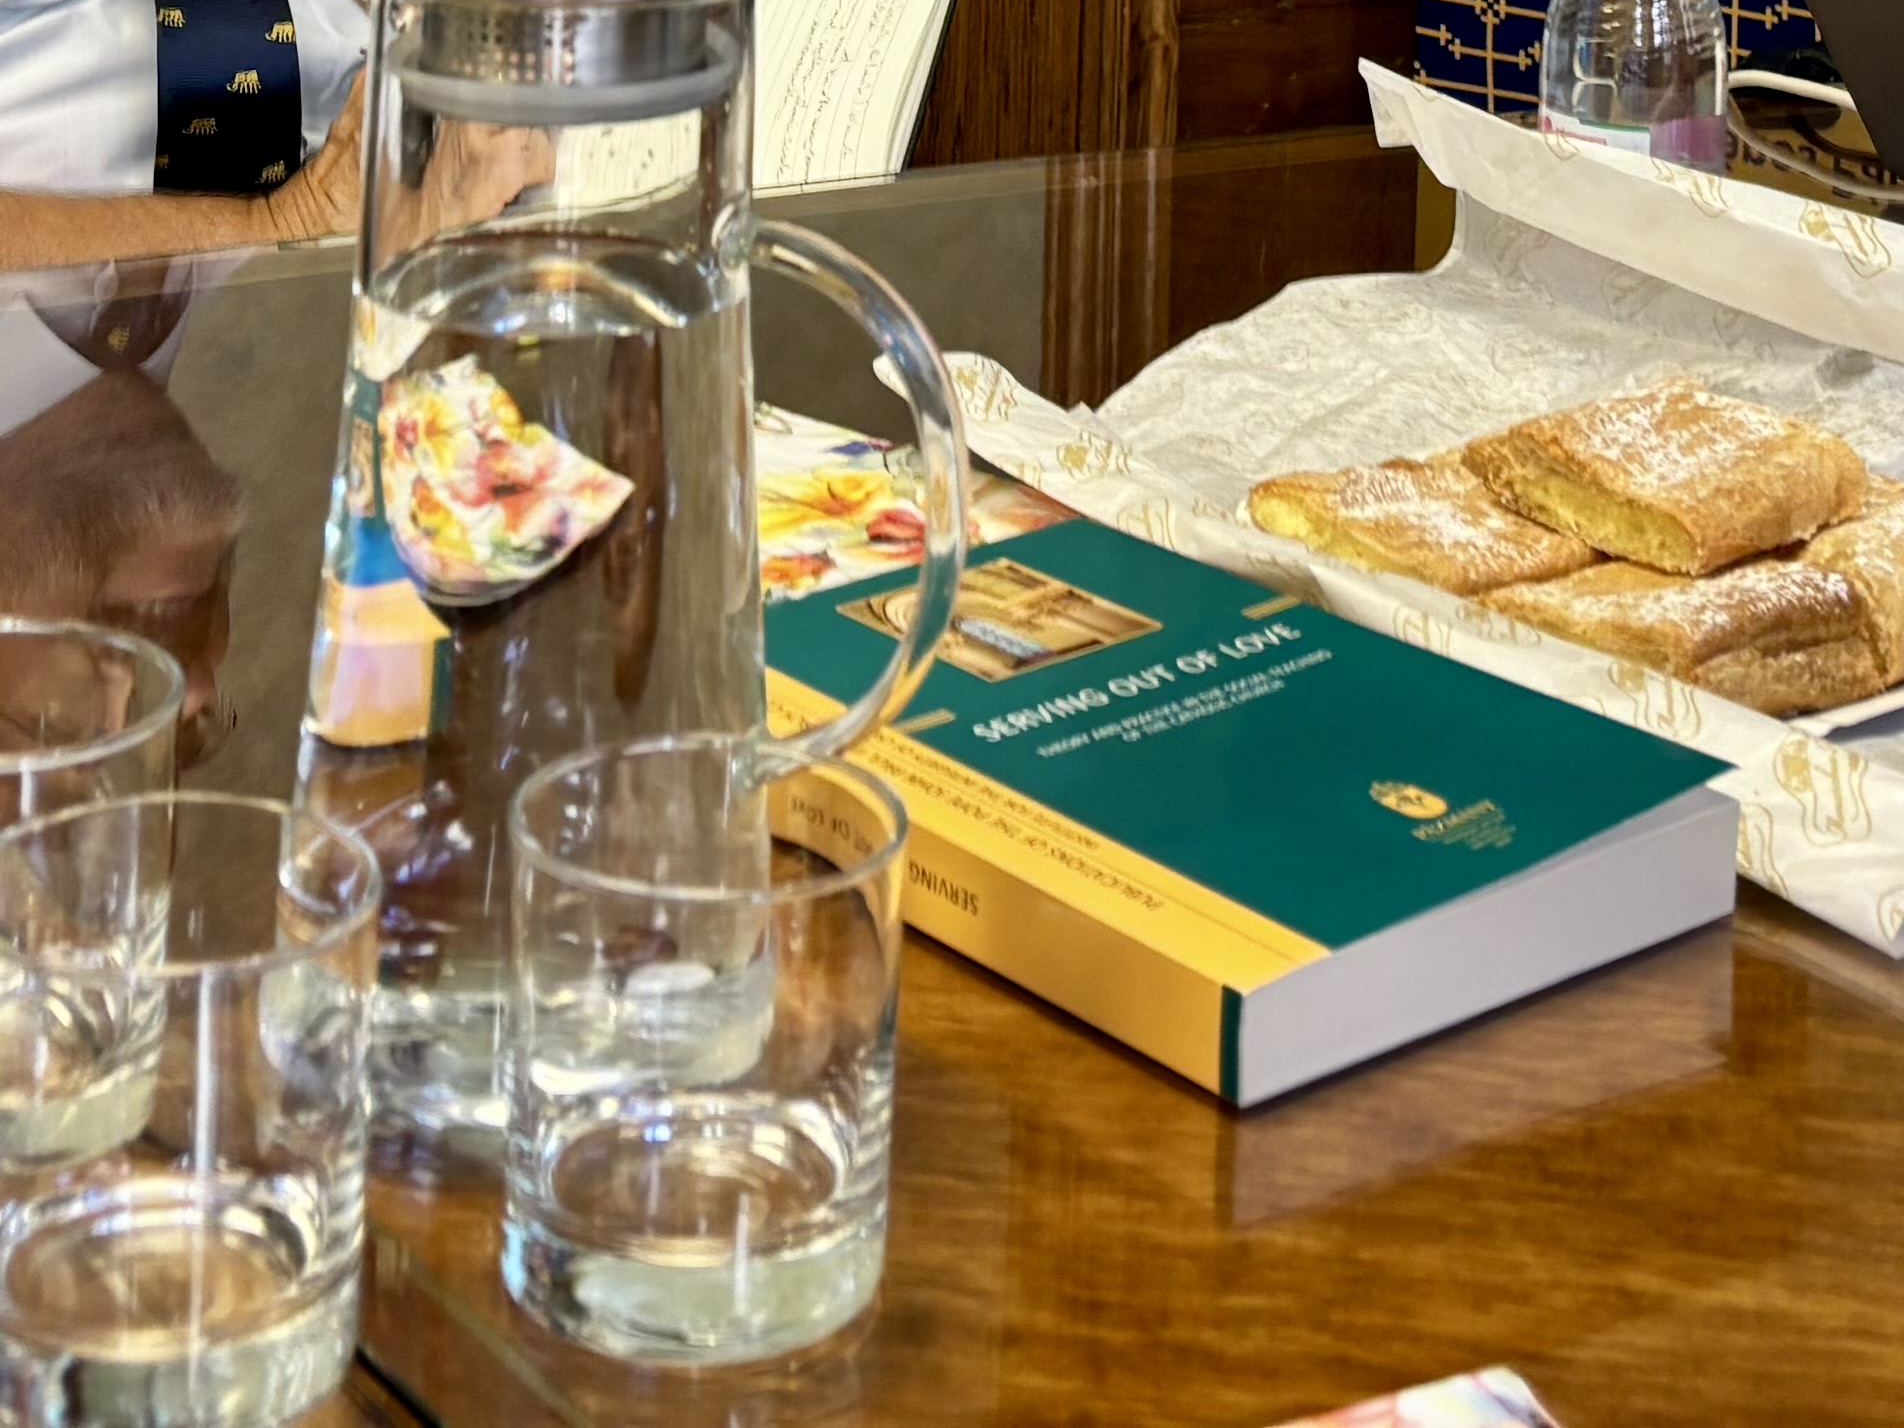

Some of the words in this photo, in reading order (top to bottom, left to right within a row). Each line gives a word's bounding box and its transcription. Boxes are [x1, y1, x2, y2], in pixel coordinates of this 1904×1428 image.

[973, 687, 1110, 743] SERVING
[1108, 664, 1176, 698] OUT
[1176, 648, 1219, 675] OF
[1219, 622, 1302, 660] LOVE
[909, 859, 980, 917] SERVING
